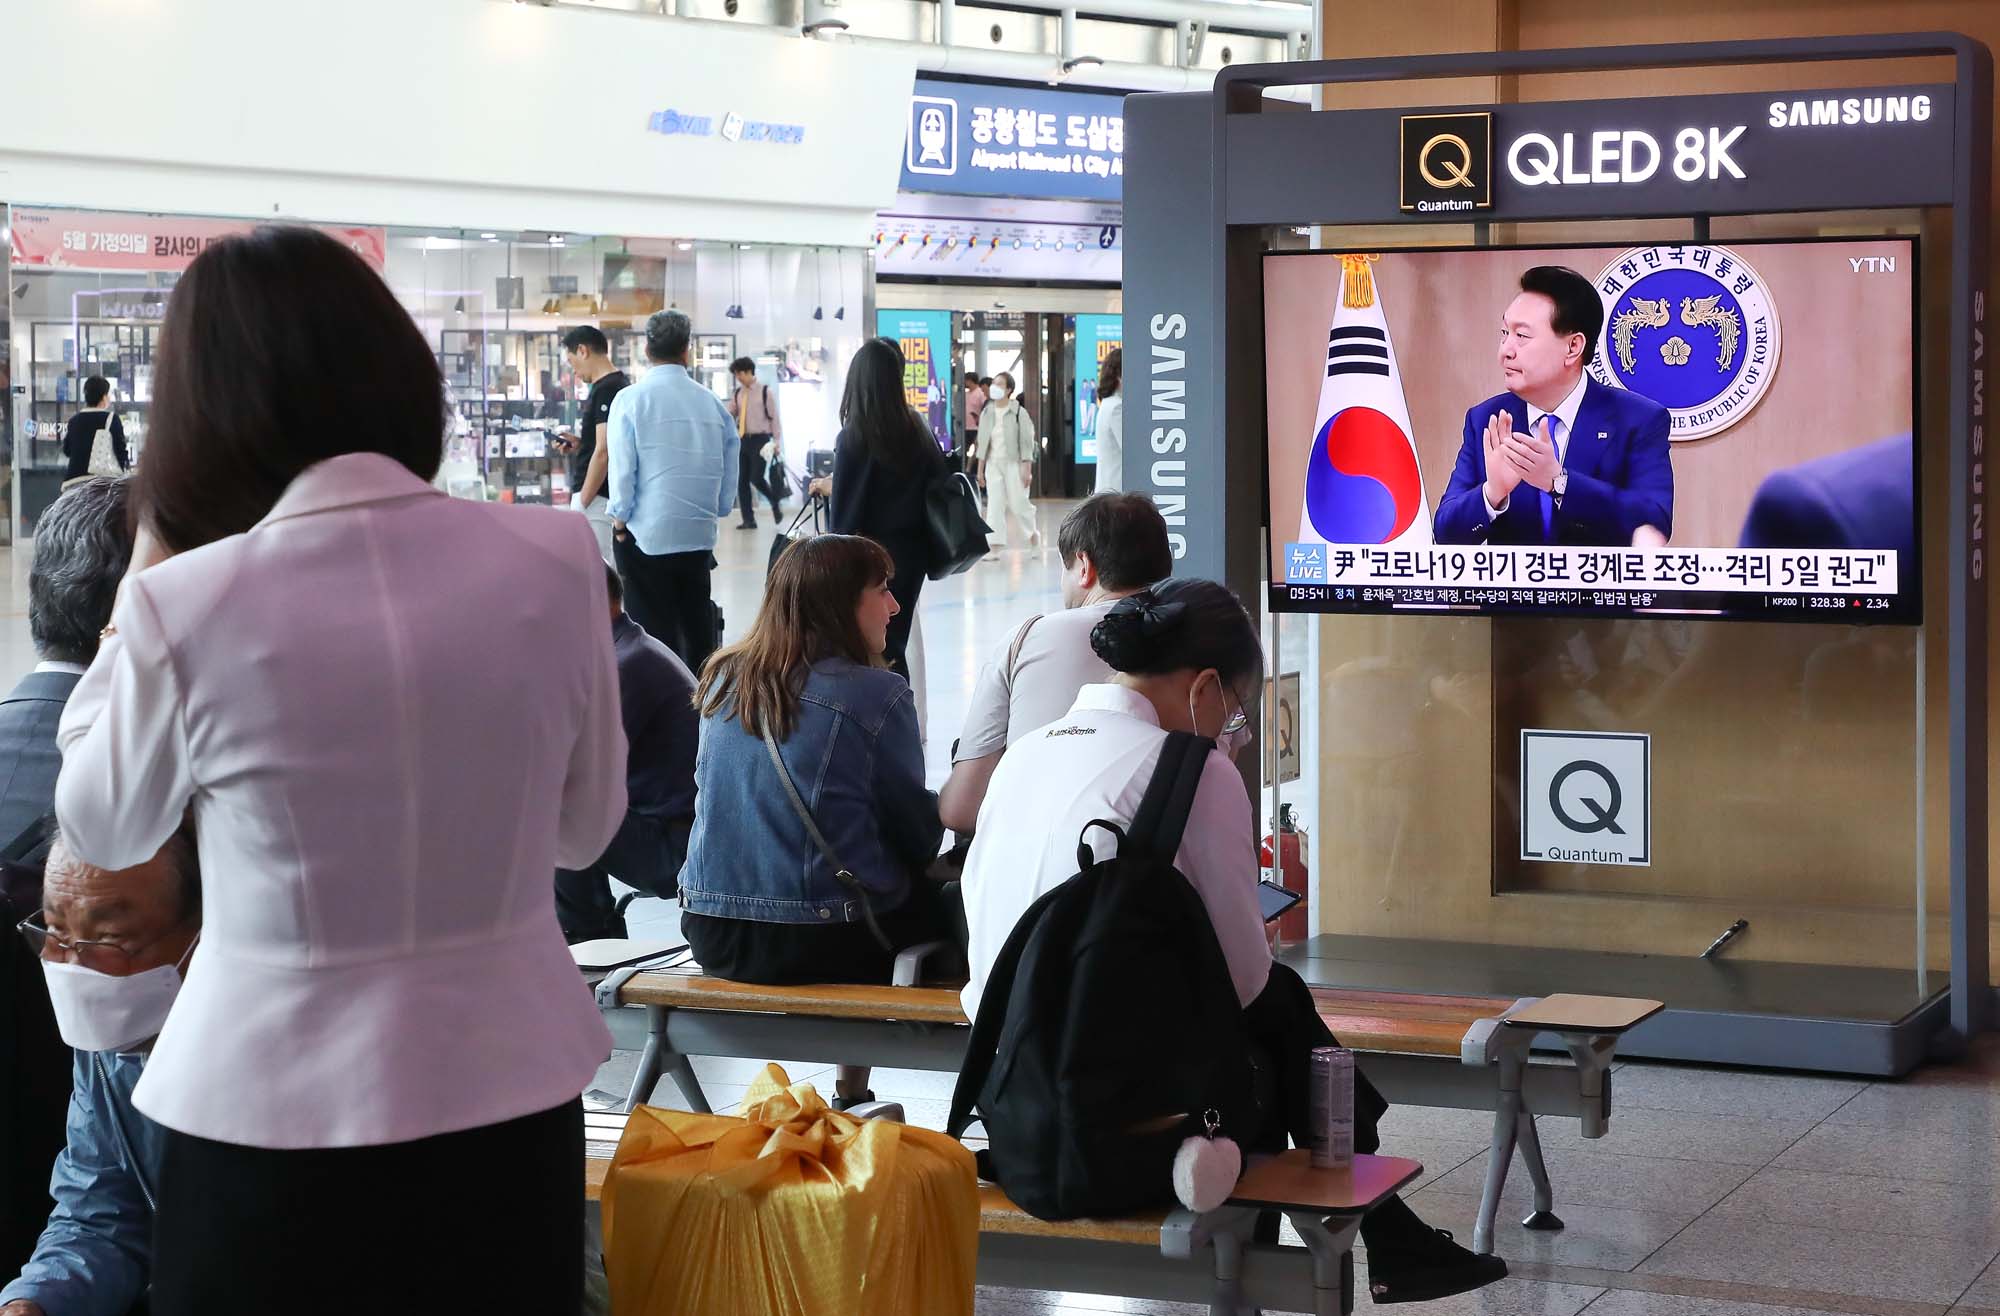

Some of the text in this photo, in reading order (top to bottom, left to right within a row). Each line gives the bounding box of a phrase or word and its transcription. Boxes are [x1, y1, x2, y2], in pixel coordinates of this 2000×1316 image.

[1769, 95, 1931, 128] SAMSUNG
[971, 106, 1058, 147] 공항철도
[971, 148, 1018, 171] Airport
[1018, 151, 1071, 172] Railroad
[1072, 154, 1083, 172] &
[1084, 155, 1110, 178] City
[1419, 133, 1475, 188] Q
[1506, 126, 1748, 186] QLED 8K
[1417, 199, 1473, 212] Quantum
[63, 230, 148, 254] 5월 가정의달
[154, 235, 200, 257] 감사의
[1602, 246, 1753, 297] 대한민국대통령
[1849, 257, 1895, 273] YTN
[1690, 384, 1749, 427] REPUBLIC
[1745, 366, 1760, 384] OF
[1753, 316, 1767, 364] KOREA
[1973, 290, 1984, 580] SAMSUNG
[1292, 549, 1320, 563] 뉴스
[1334, 551, 1355, 578] 尹
[1362, 549, 1466, 581] "코로나19
[1473, 551, 1517, 582] 위기
[1525, 552, 1570, 582] 경보
[1578, 552, 1646, 584] 경계로
[1782, 555, 1818, 586] 5일
[1828, 554, 1885, 586] 권고"
[1289, 566, 1322, 579] LIVE
[1290, 588, 1324, 600] 09:54
[1335, 588, 1355, 600] 정치
[1362, 589, 1395, 602] 윤재옥
[1398, 589, 1434, 602] "간호법
[1437, 590, 1462, 604] 제정,
[1465, 590, 1509, 604] 다수당의
[1512, 591, 1534, 604] 직역
[1772, 598, 1797, 607] KP200
[1810, 597, 1889, 609] 328.38 2.34
[1550, 760, 1626, 834] Q
[1548, 846, 1623, 863] Quantum
